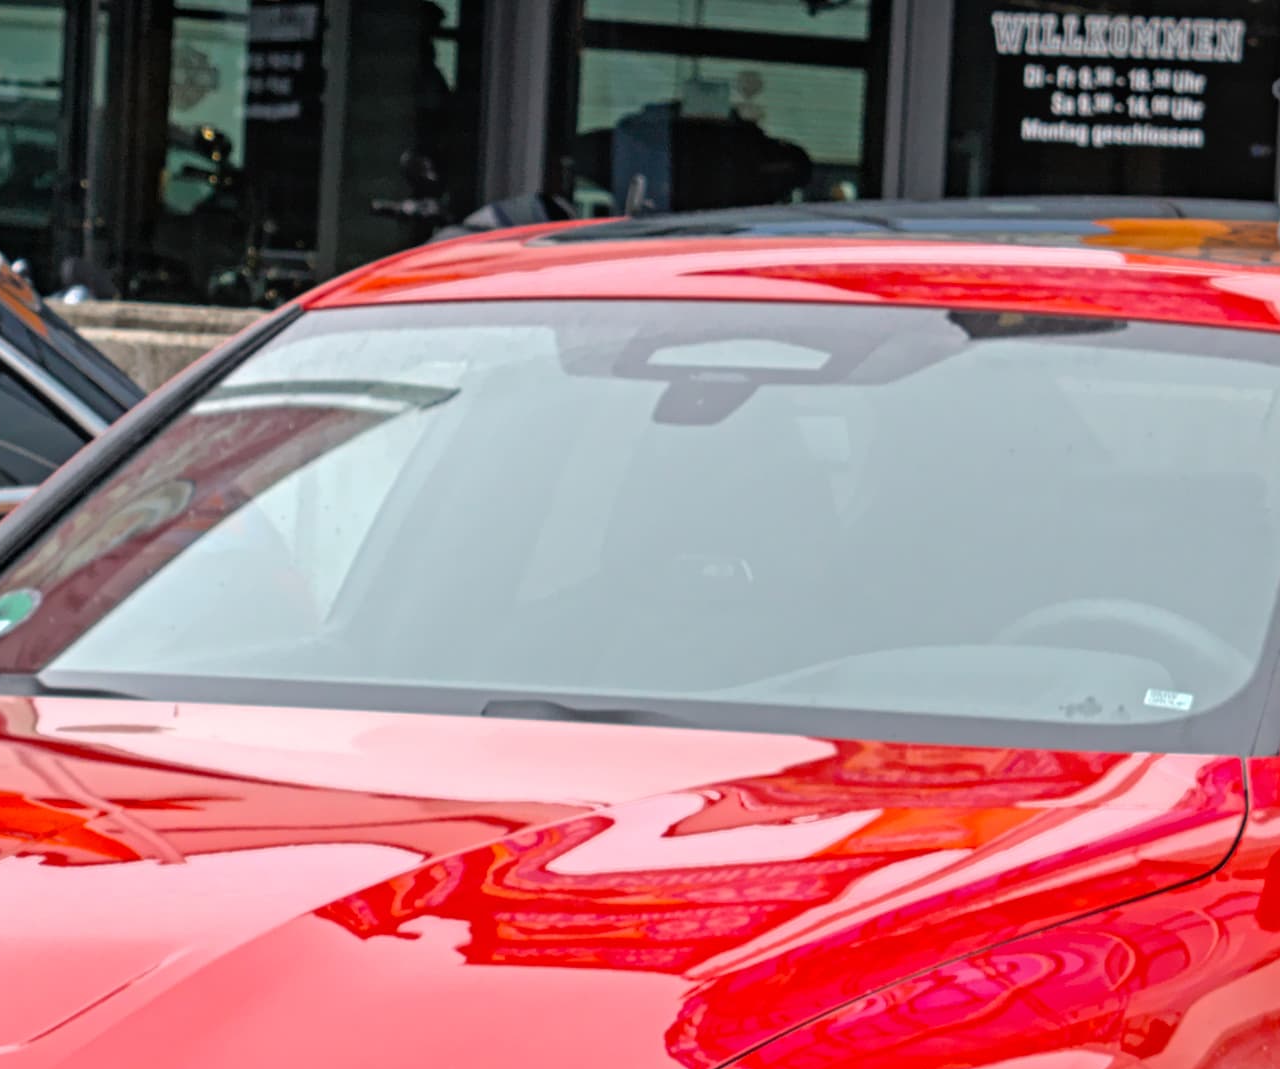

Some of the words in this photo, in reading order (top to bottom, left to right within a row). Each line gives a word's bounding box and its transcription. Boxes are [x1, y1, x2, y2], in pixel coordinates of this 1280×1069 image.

[992, 12, 1246, 62] WILLKOMMEN
[1173, 70, 1206, 94] Uhr
[1051, 91, 1076, 116] Sa
[1171, 97, 1205, 120] Uhr
[1021, 118, 1089, 147] Montag
[1091, 122, 1204, 148] geschlossen
